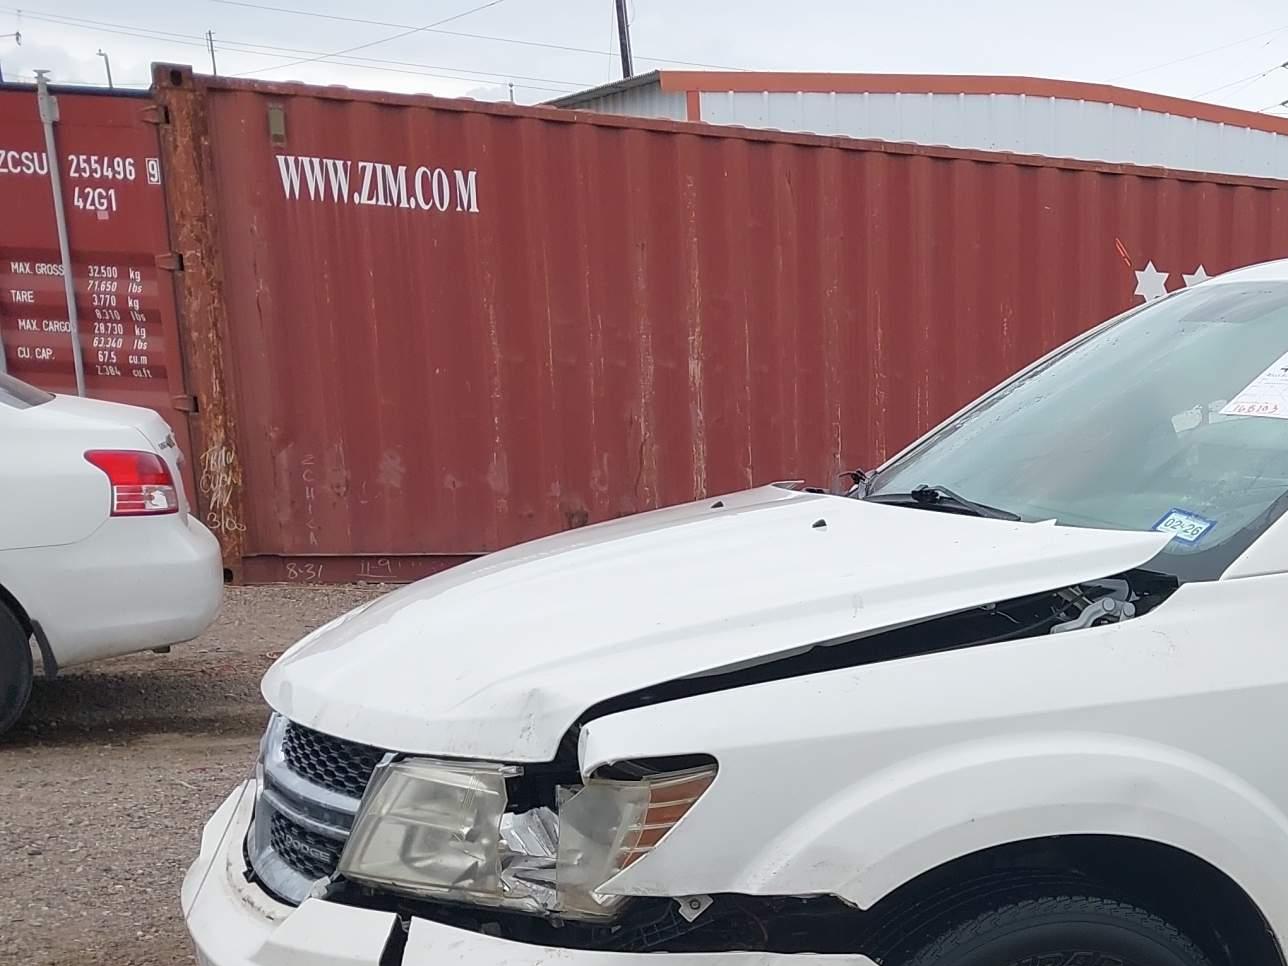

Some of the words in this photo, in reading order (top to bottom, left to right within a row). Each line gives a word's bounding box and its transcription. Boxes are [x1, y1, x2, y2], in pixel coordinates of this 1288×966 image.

[68, 154, 136, 181] 255496
[147, 159, 159, 183] 9
[275, 154, 480, 213] WWW.ZIM.COM
[73, 186, 117, 212] 42G1
[10, 262, 33, 274] MAX.
[35, 263, 66, 276] GROSS
[88, 265, 118, 278] 32.500
[129, 267, 141, 282] kg
[87, 280, 117, 292] 71.650
[128, 282, 143, 293] lbs
[10, 289, 35, 303] TARE
[92, 294, 117, 307] 3.770
[127, 296, 140, 310] kg
[42, 320, 71, 333] CARGO
[93, 322, 124, 335] 28.730
[135, 324, 147, 339] kg
[133, 338, 148, 350] lbs
[35, 347, 55, 360] CAP.
[98, 350, 117, 363] 67.5
[285, 833, 331, 863] DODGE
